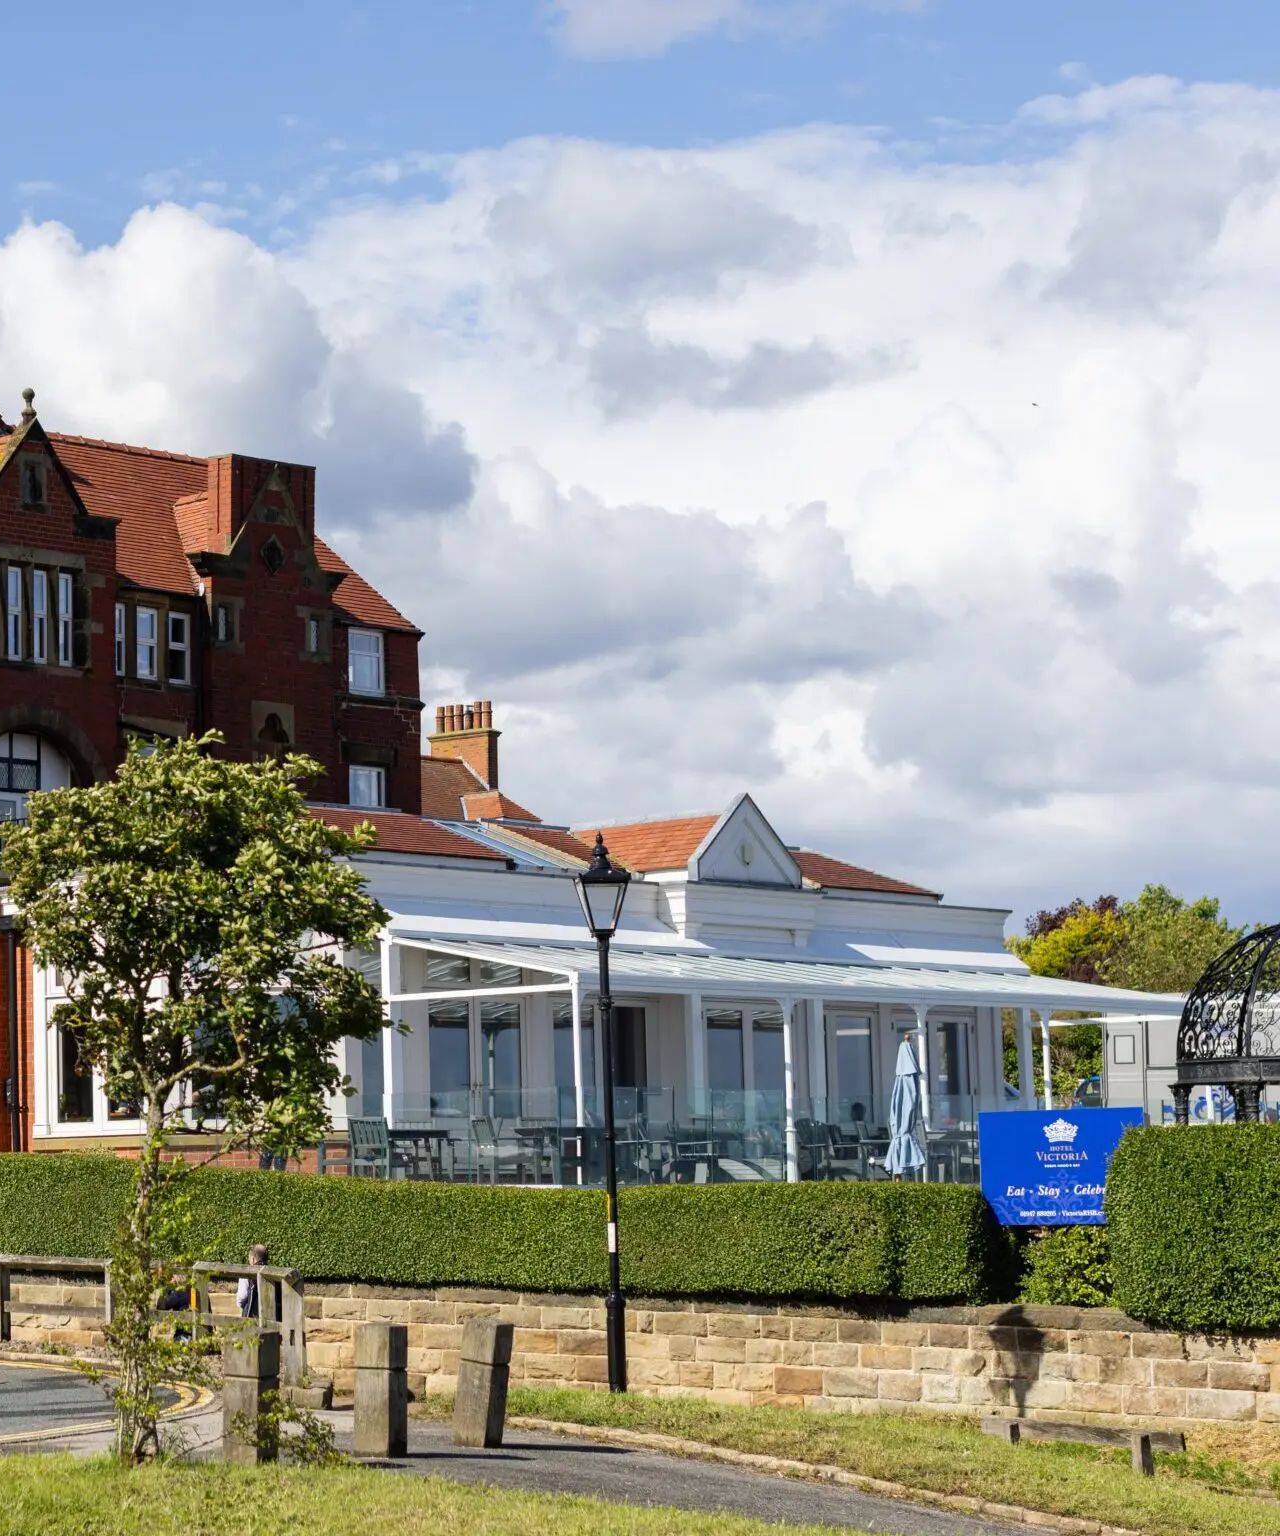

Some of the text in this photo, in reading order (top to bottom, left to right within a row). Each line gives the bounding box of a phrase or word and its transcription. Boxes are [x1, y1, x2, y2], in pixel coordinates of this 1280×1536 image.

[1036, 1150, 1088, 1161] VICTORIA
[1006, 1185, 1025, 1197] Eat
[1037, 1185, 1060, 1199] Stay
